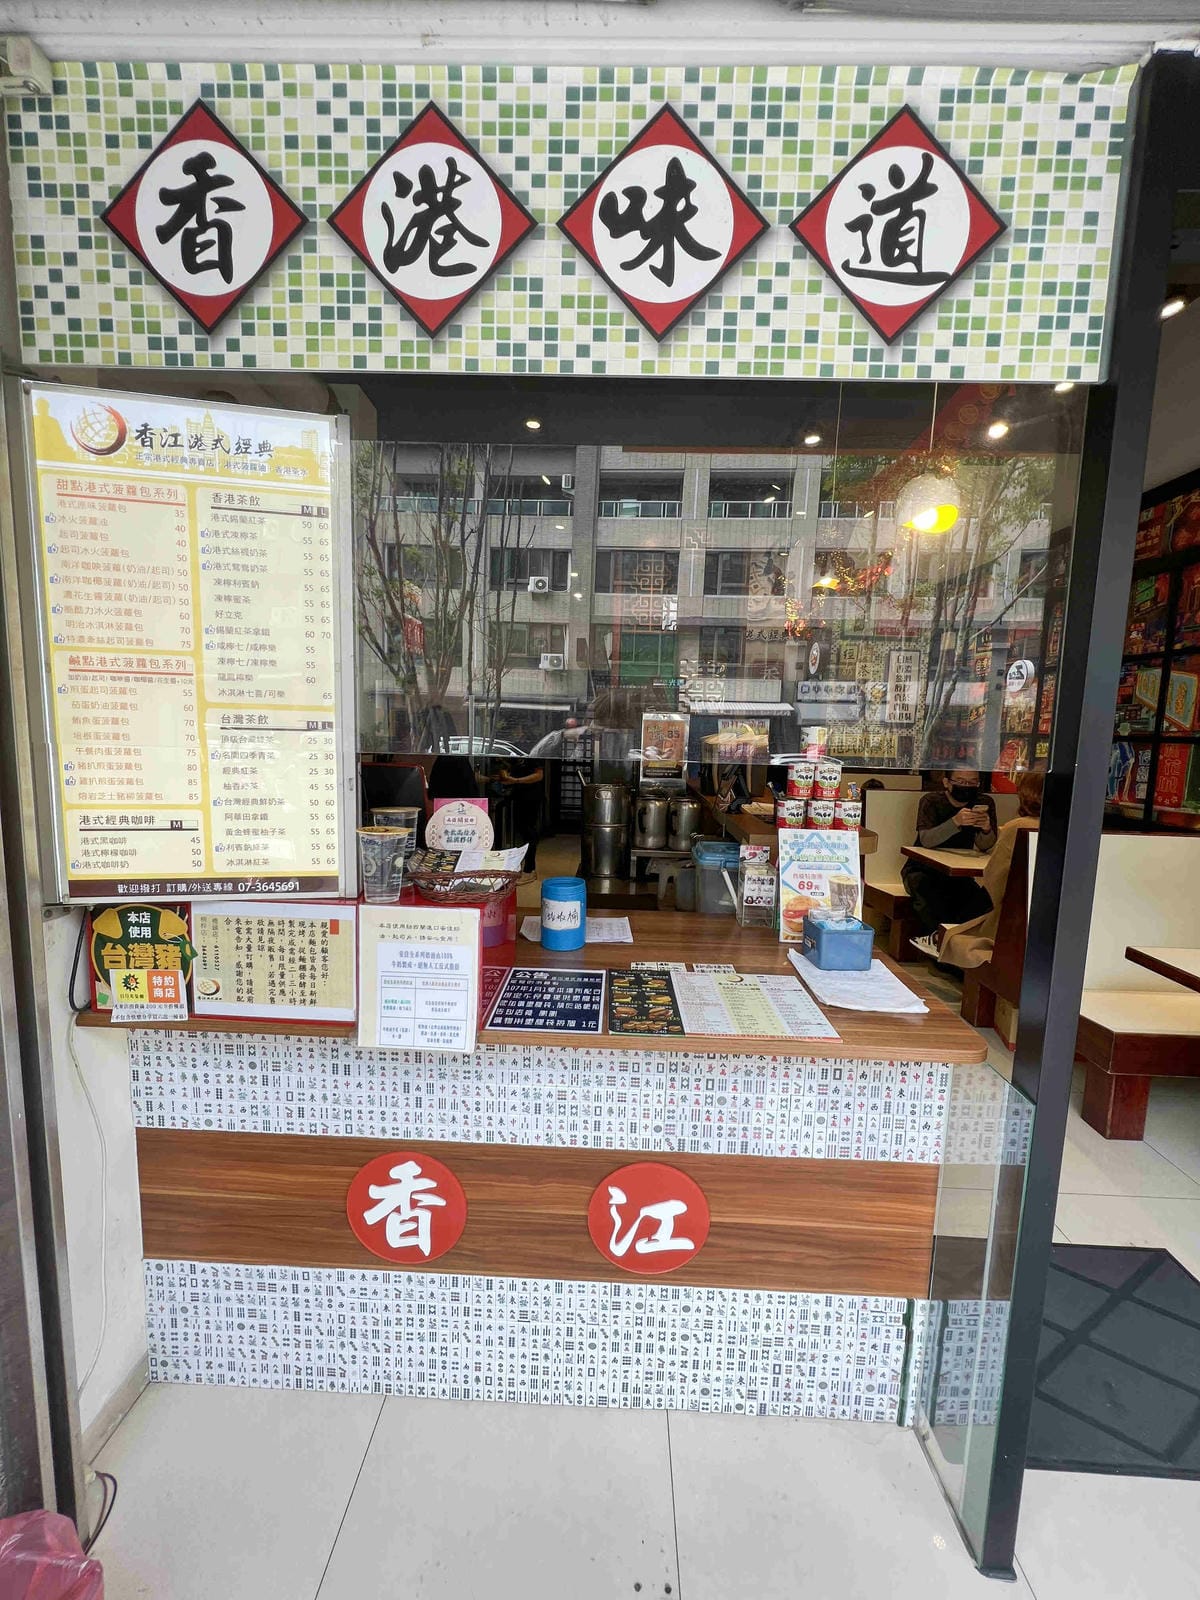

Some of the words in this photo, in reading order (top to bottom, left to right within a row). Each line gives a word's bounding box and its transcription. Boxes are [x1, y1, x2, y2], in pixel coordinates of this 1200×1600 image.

[135, 422, 273, 458] 香江港式經典
[56, 478, 178, 499] 甜點港式菠蘿包系列
[211, 492, 260, 506] 香港茶飲
[303, 506, 312, 515] M
[319, 522, 328, 530] 60
[303, 537, 312, 545] 55
[319, 538, 329, 546] 65
[177, 554, 187, 562] 50
[212, 546, 267, 558] 港式絲襪奶茶
[319, 554, 329, 562] 65
[177, 569, 188, 577] 50
[179, 598, 189, 606] 50
[321, 601, 330, 609] 65
[215, 610, 243, 620] 好立克
[321, 616, 330, 624] 65
[69, 655, 186, 670] 鹹點港式菠蘿包系列
[323, 692, 332, 700] 65
[183, 704, 193, 712] 60
[184, 719, 194, 727] 70
[221, 714, 269, 725] 台灣茶飲
[309, 721, 317, 729] M
[185, 734, 195, 742] 70
[308, 737, 318, 745] 25
[323, 737, 333, 745] 30
[324, 753, 334, 761] 30
[222, 767, 258, 775] 經典紅茶
[309, 783, 319, 791] 45
[224, 798, 285, 806] 台灣經典鮮奶茶
[79, 815, 156, 825] 港式經典咖啡
[225, 813, 268, 821] 阿華田拿鐵
[225, 828, 286, 836] 黃金蜂蜜柚子茶
[80, 836, 127, 845] 港式黑咖啡
[311, 843, 321, 851] 55
[81, 849, 137, 857] 港式檸檬咖啡
[191, 848, 201, 856] 50
[82, 861, 129, 869] 港式咖啡奶
[226, 858, 270, 866] 冰淇淋紅茶
[118, 884, 160, 894] 歡迎撥打
[238, 881, 300, 892] 07-3645691
[127, 912, 150, 924] 本店
[128, 926, 151, 938] 使用
[101, 942, 182, 969] 台灣豬
[153, 976, 174, 986] 特約
[154, 988, 175, 998] 商店
